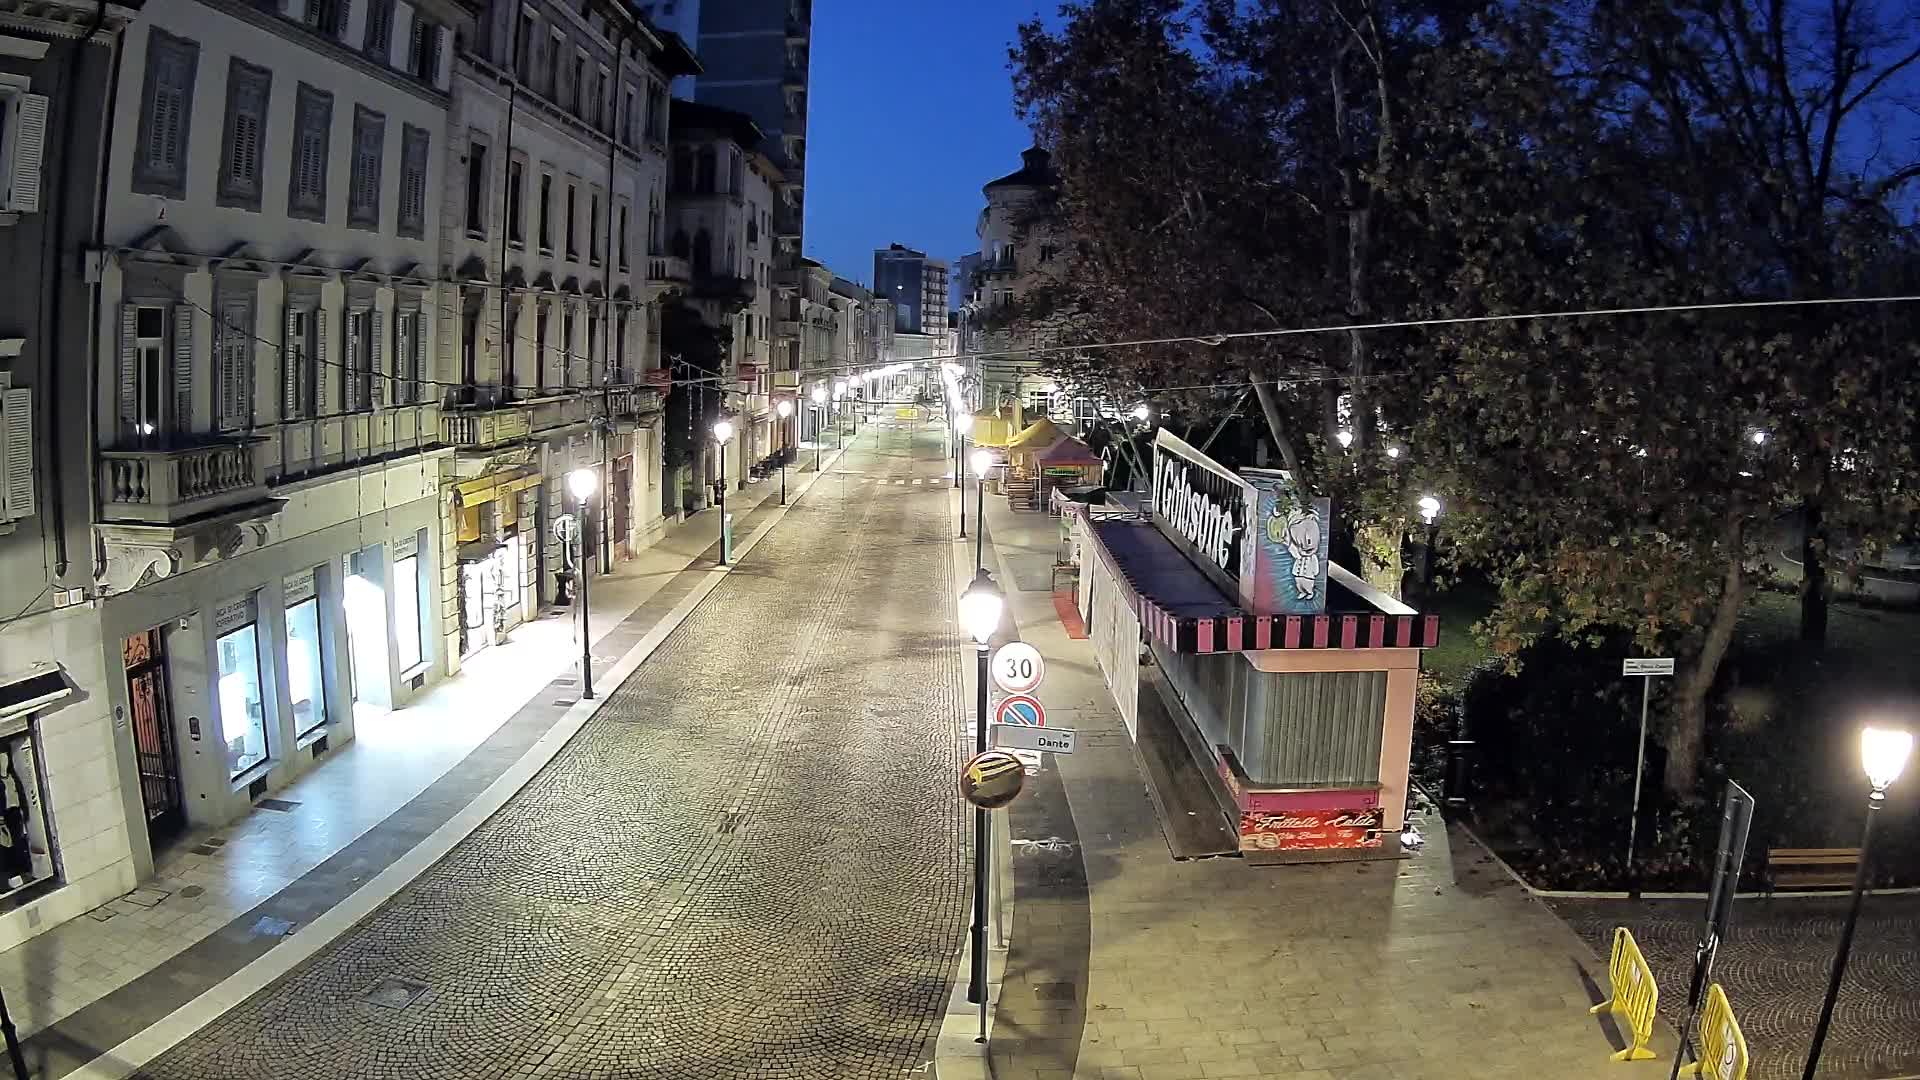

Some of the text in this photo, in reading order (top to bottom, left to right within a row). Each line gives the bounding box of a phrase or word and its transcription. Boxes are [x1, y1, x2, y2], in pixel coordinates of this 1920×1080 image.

[1162, 458, 1242, 569] Golosone
[1006, 658, 1032, 679] 30
[1038, 737, 1070, 749] Dante
